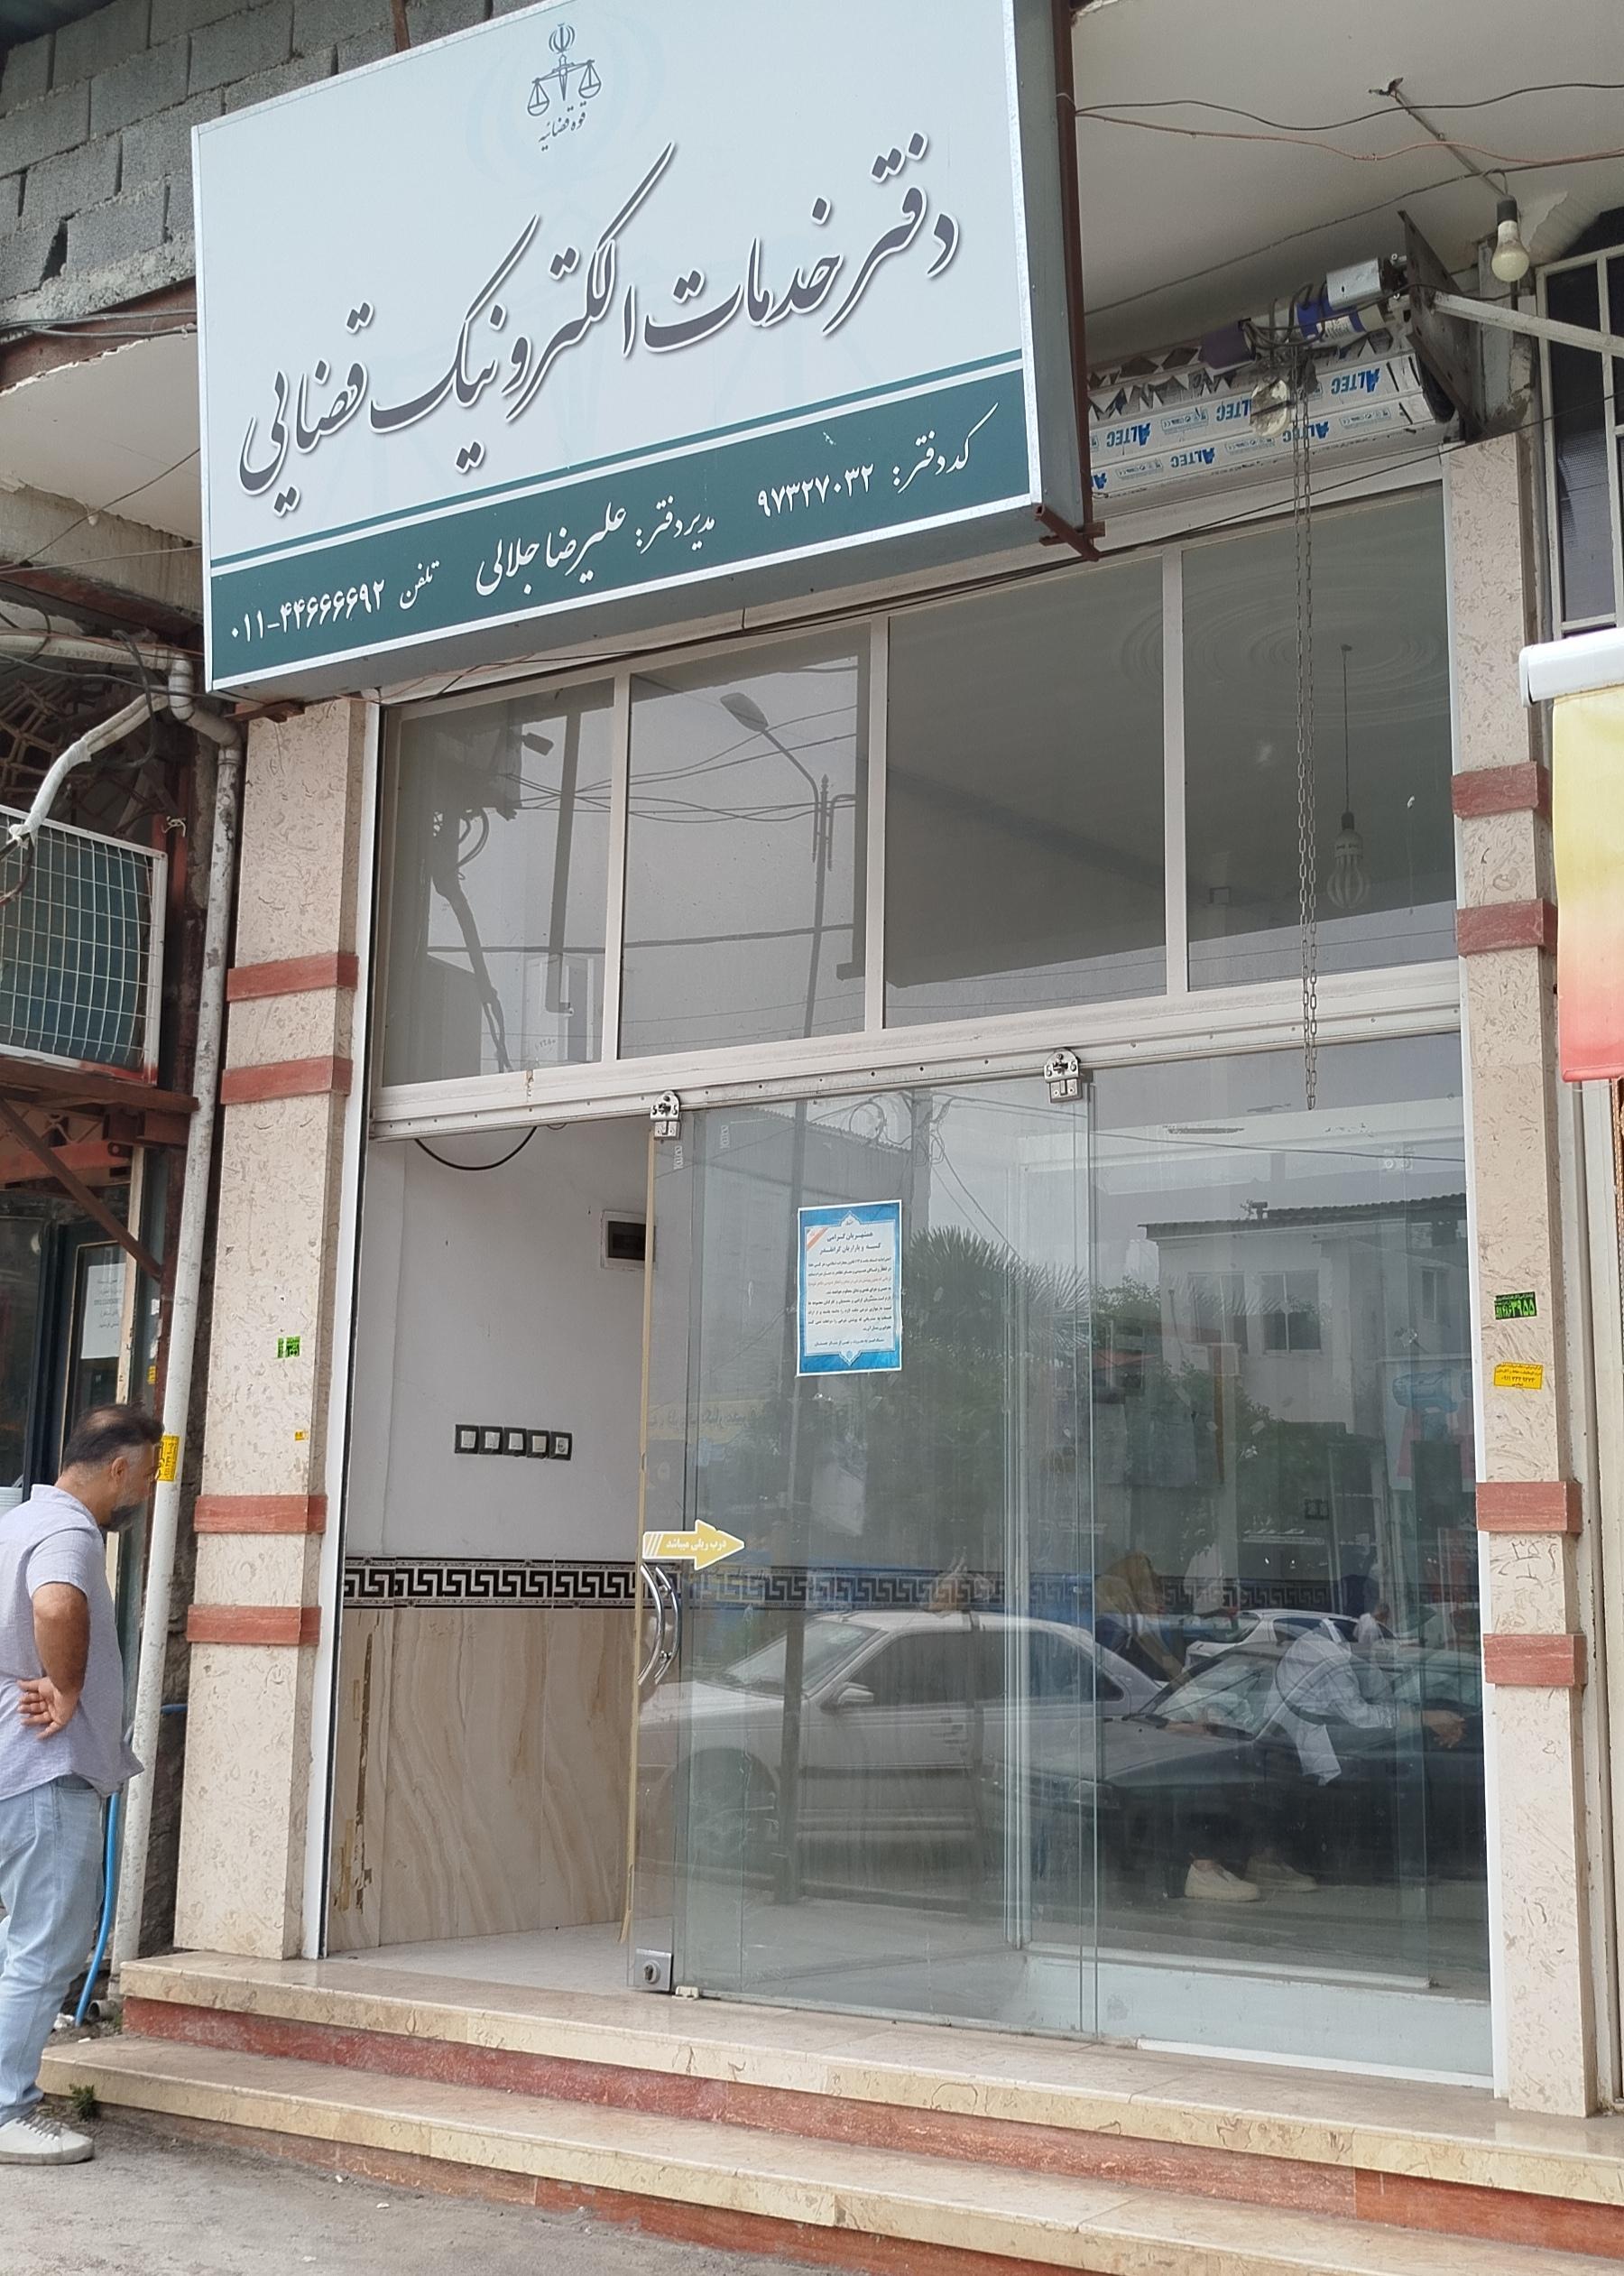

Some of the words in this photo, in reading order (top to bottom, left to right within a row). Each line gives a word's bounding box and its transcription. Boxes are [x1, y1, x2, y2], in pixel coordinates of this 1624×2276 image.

[821, 131, 961, 338] دفتر
[642, 195, 844, 355] خدمات
[368, 139, 677, 474] الکترونیک
[1331, 367, 1380, 393] ALTEC
[1106, 422, 1151, 447] ALTEC
[1215, 398, 1253, 422] LTEC
[946, 402, 1000, 475] کد
[1170, 447, 1215, 468] ALTEC
[757, 463, 875, 517] ۹۷۳۲۷۰۳۲
[544, 501, 628, 584] علیرضا
[684, 510, 716, 551] مدیر
[399, 560, 440, 610] تلفن
[475, 538, 540, 597] جلالی
